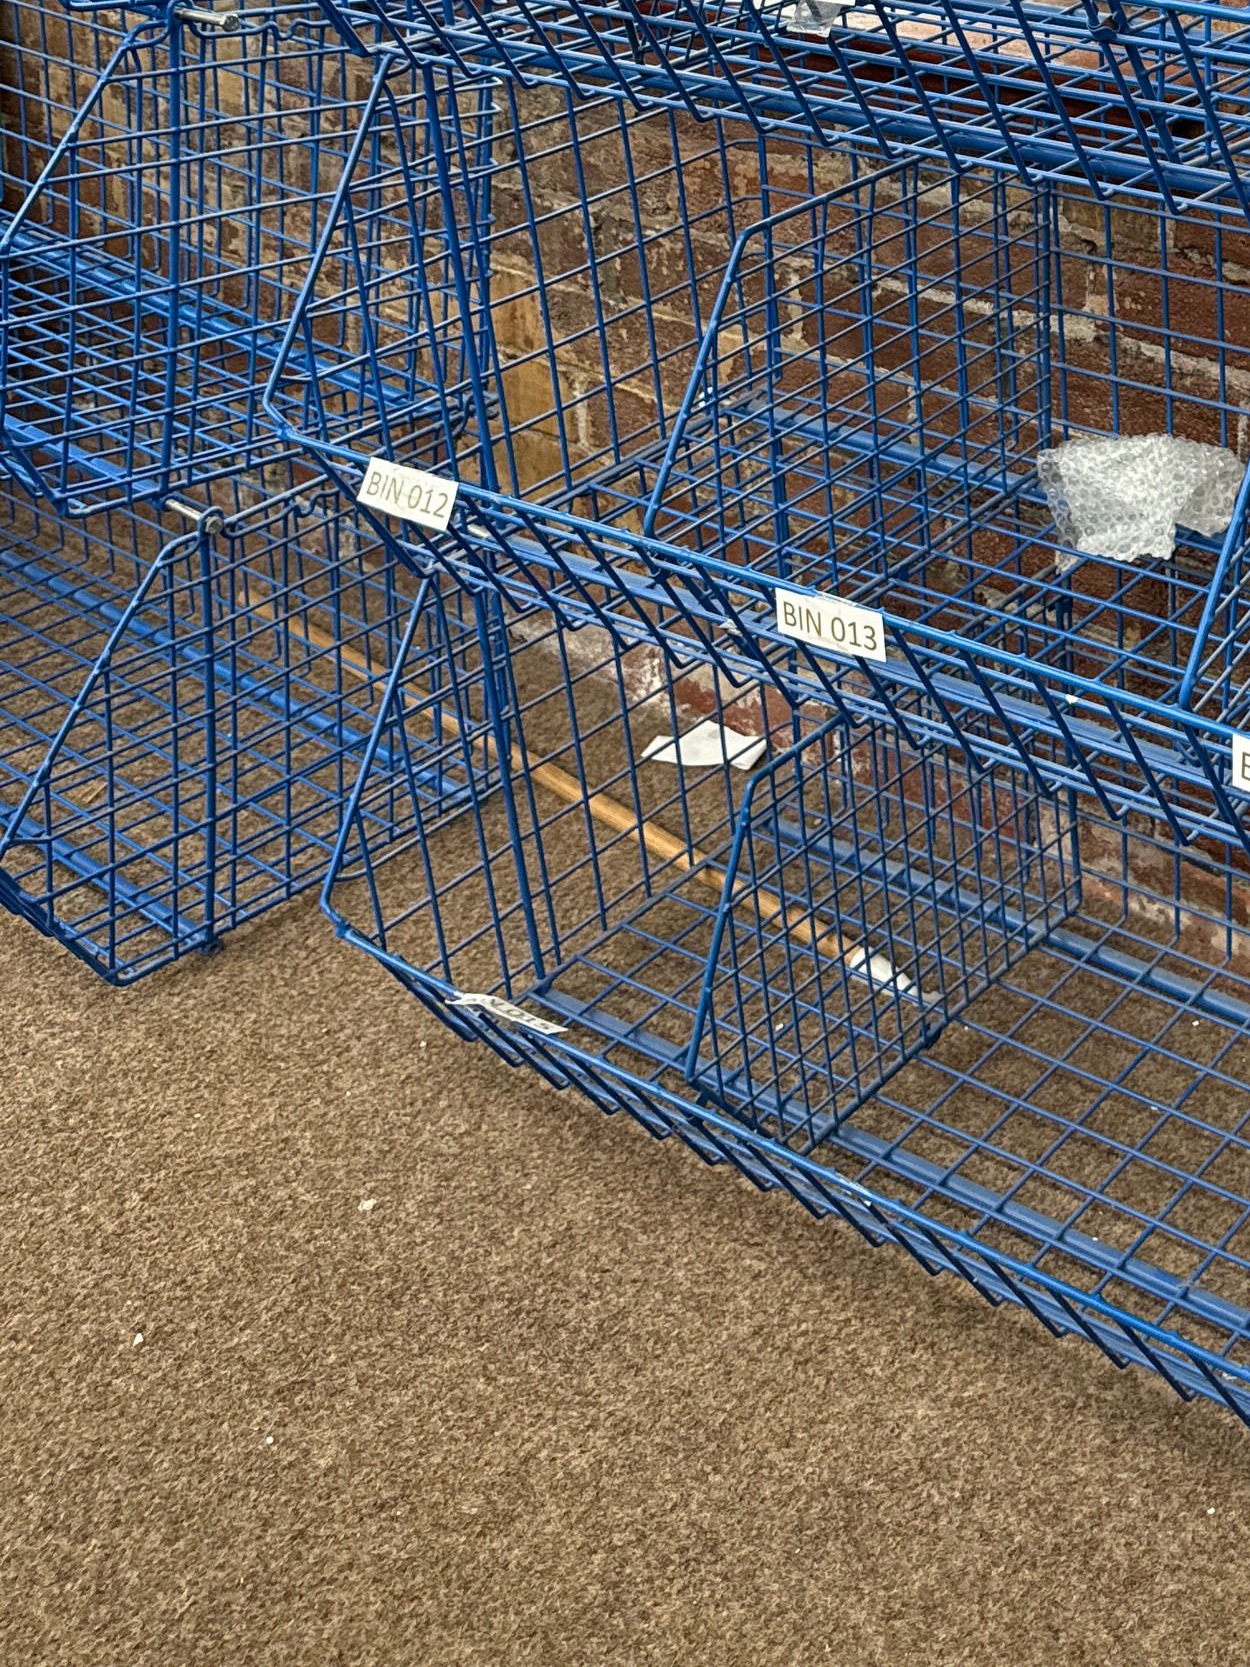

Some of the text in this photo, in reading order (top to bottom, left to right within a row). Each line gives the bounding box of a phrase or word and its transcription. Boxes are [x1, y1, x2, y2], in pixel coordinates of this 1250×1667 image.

[366, 471, 448, 518] BIN 012
[783, 601, 877, 651] BIN 013
